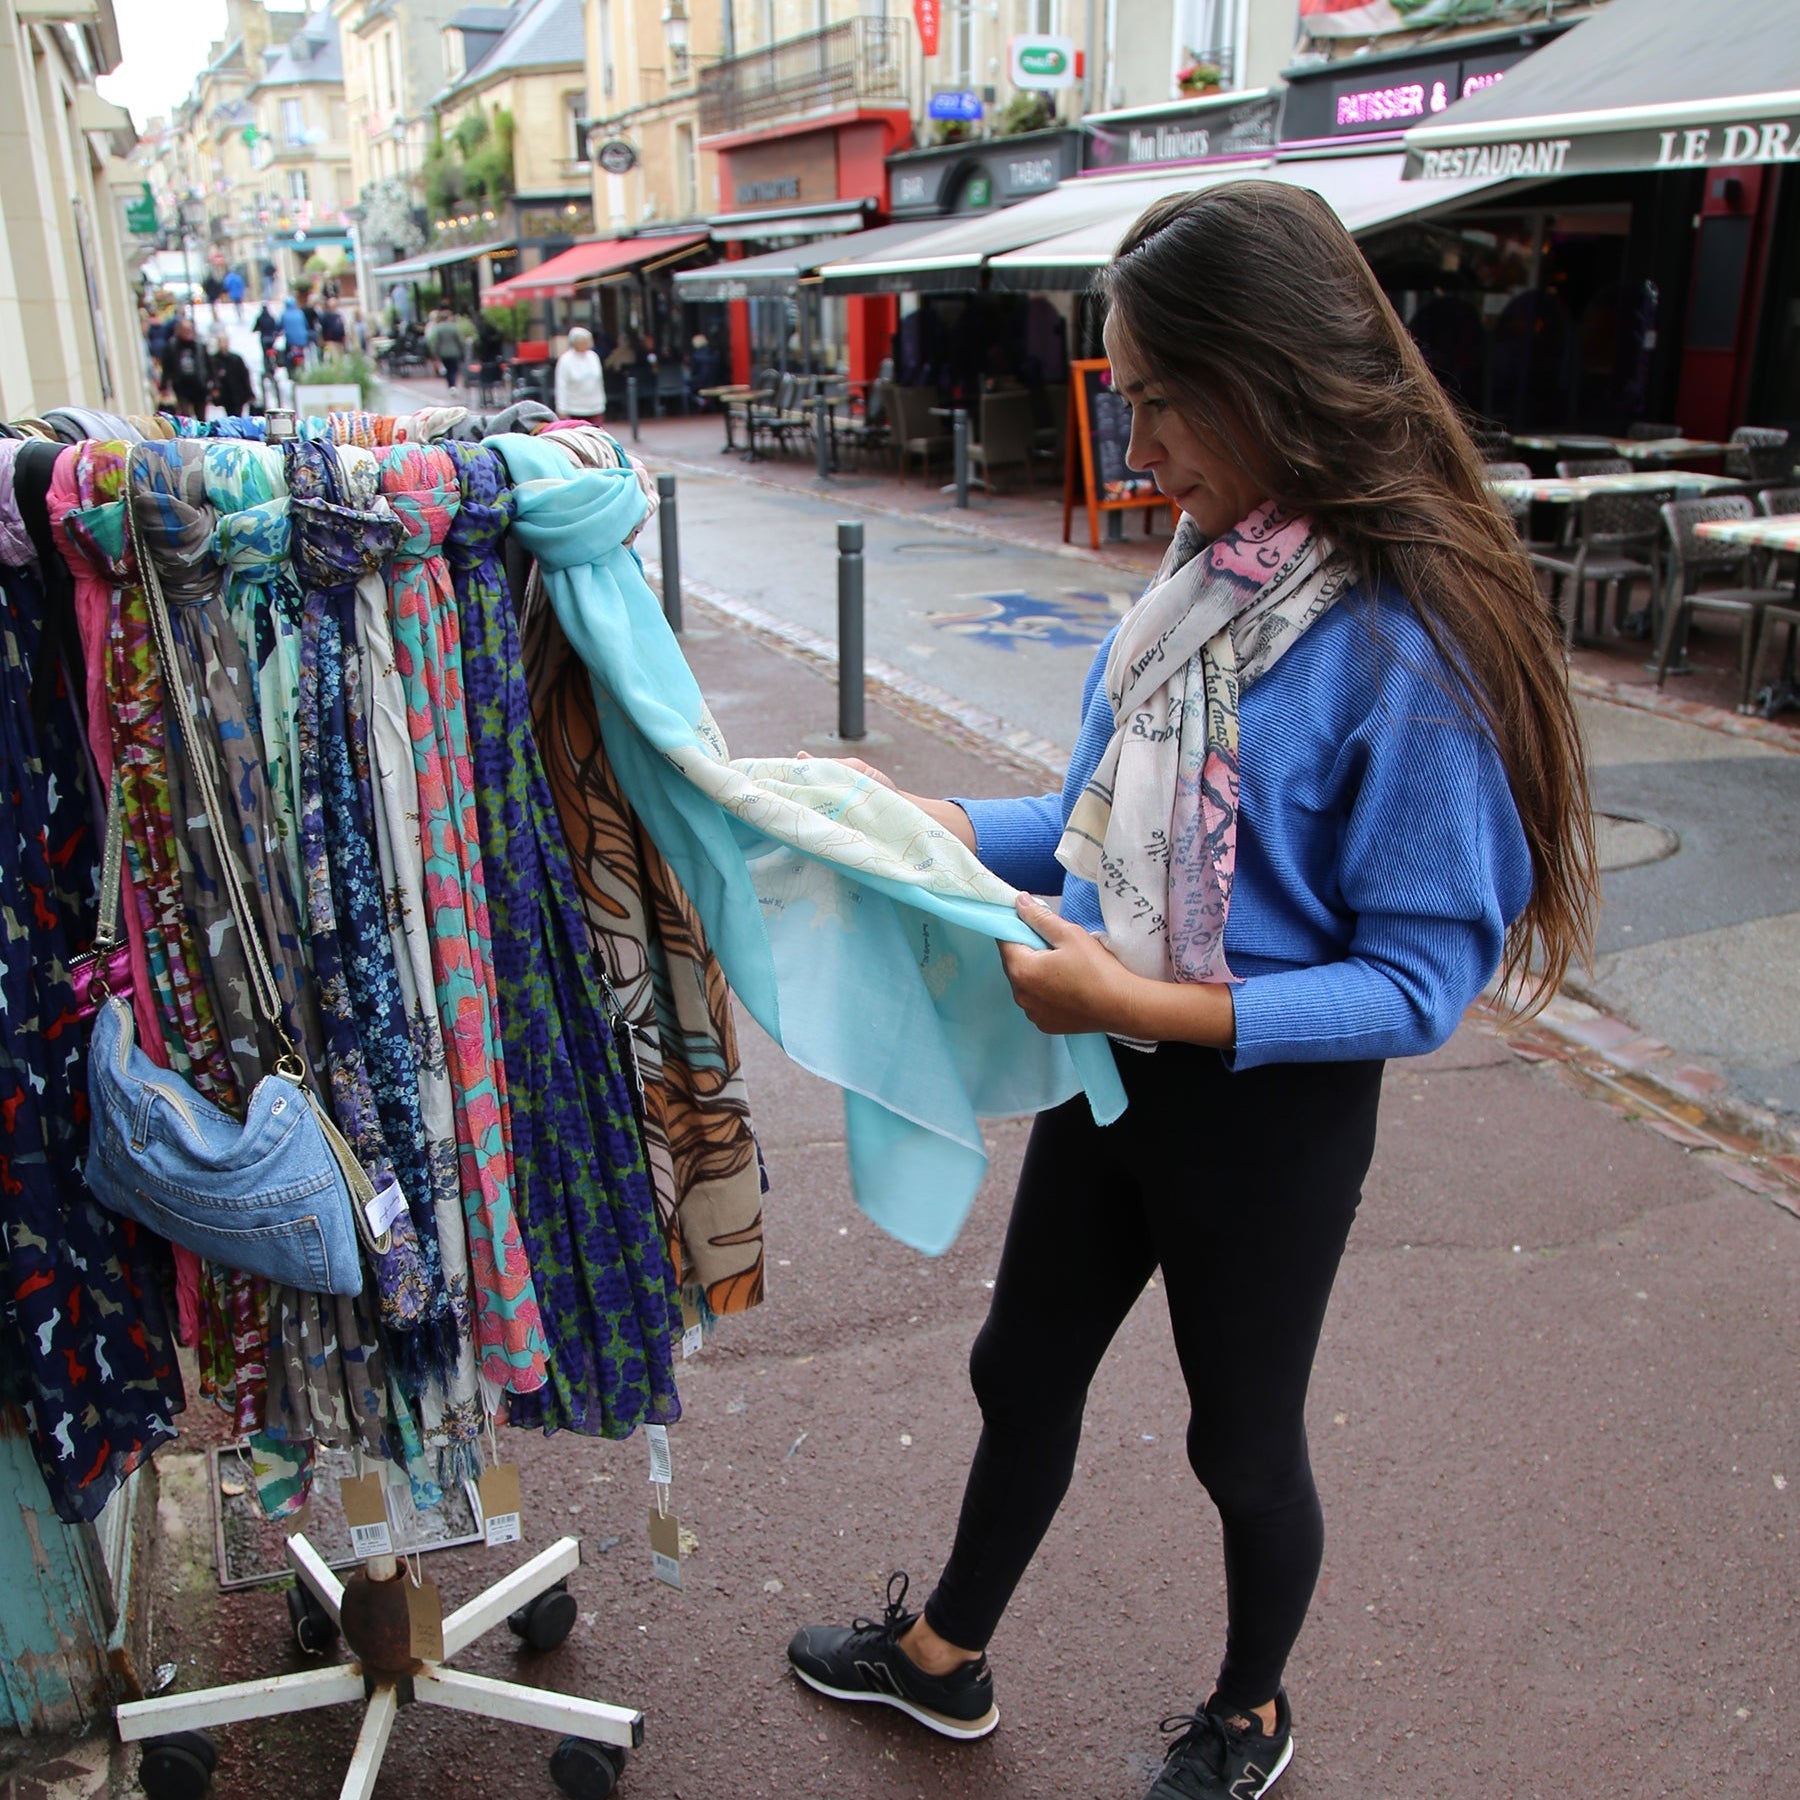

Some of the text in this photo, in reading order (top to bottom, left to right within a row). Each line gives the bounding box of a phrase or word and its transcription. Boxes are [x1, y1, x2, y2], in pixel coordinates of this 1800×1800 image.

[1337, 84, 1424, 125] PATISSIER
[1422, 141, 1571, 180] RESTAURANT
[1655, 129, 1710, 168] LE
[1008, 159, 1053, 187] TABAC
